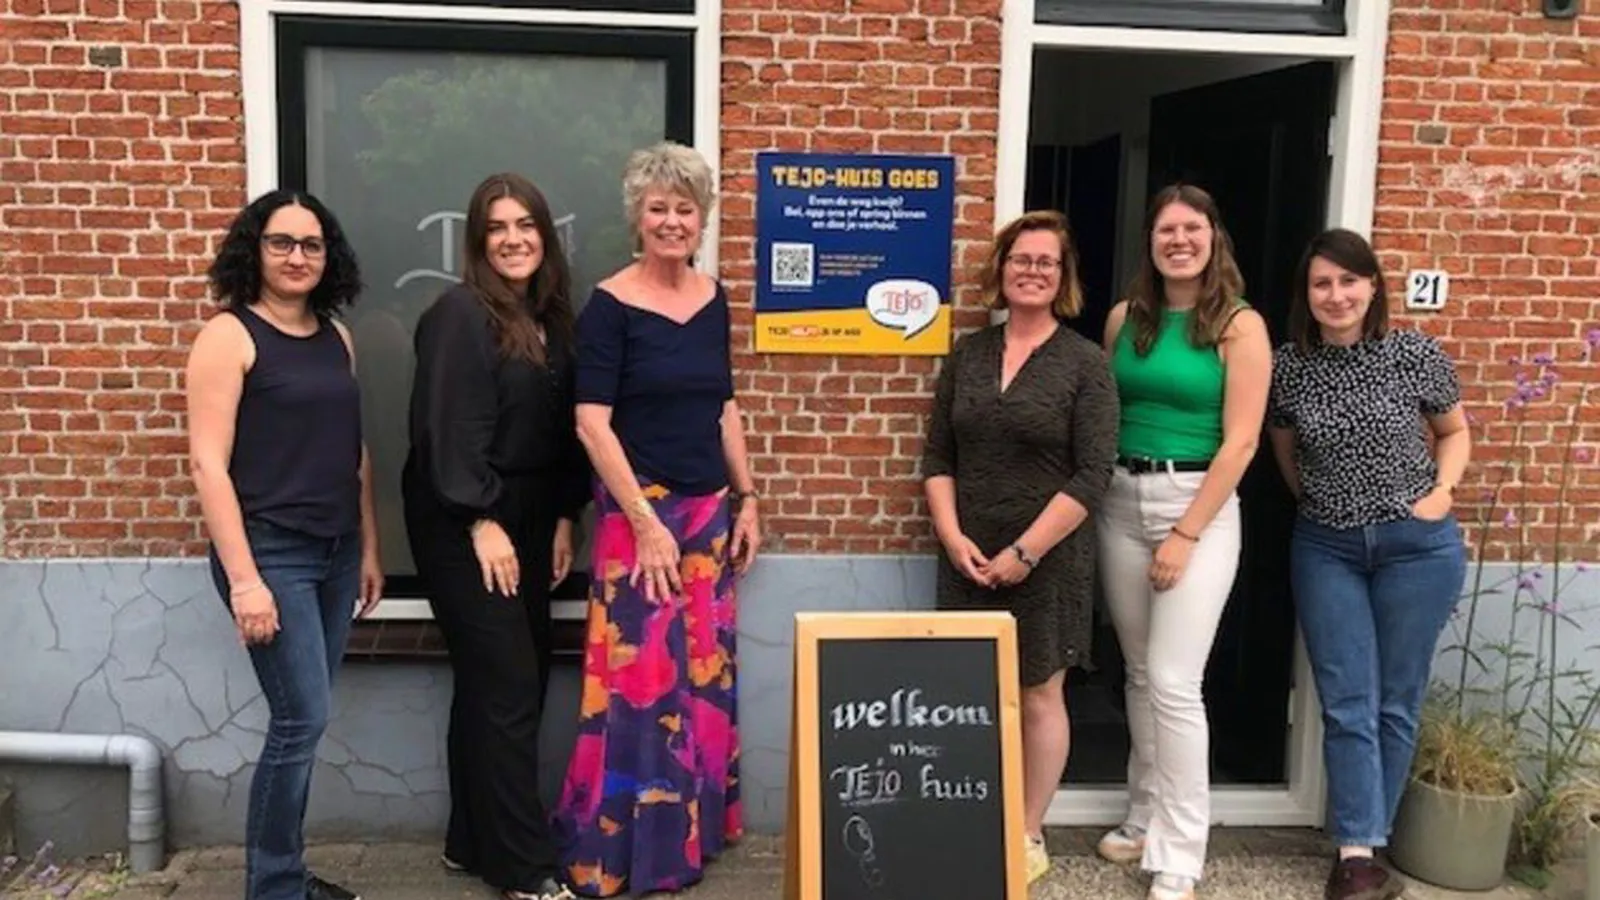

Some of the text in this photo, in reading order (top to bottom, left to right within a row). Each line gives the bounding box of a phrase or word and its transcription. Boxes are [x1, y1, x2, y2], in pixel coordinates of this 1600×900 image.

[772, 166, 939, 189] TEJO-HUIS GOES
[808, 194, 834, 206] Even
[835, 195, 848, 206] de
[849, 198, 871, 208] weg
[805, 208, 825, 219] app
[827, 208, 845, 218] ons
[847, 207, 858, 218] of
[860, 208, 890, 220] spring
[892, 207, 927, 219] binnen
[812, 220, 825, 230] en
[846, 219, 857, 231] je
[1413, 273, 1440, 304] 21
[831, 688, 993, 729] welkom
[920, 763, 988, 800] huis
